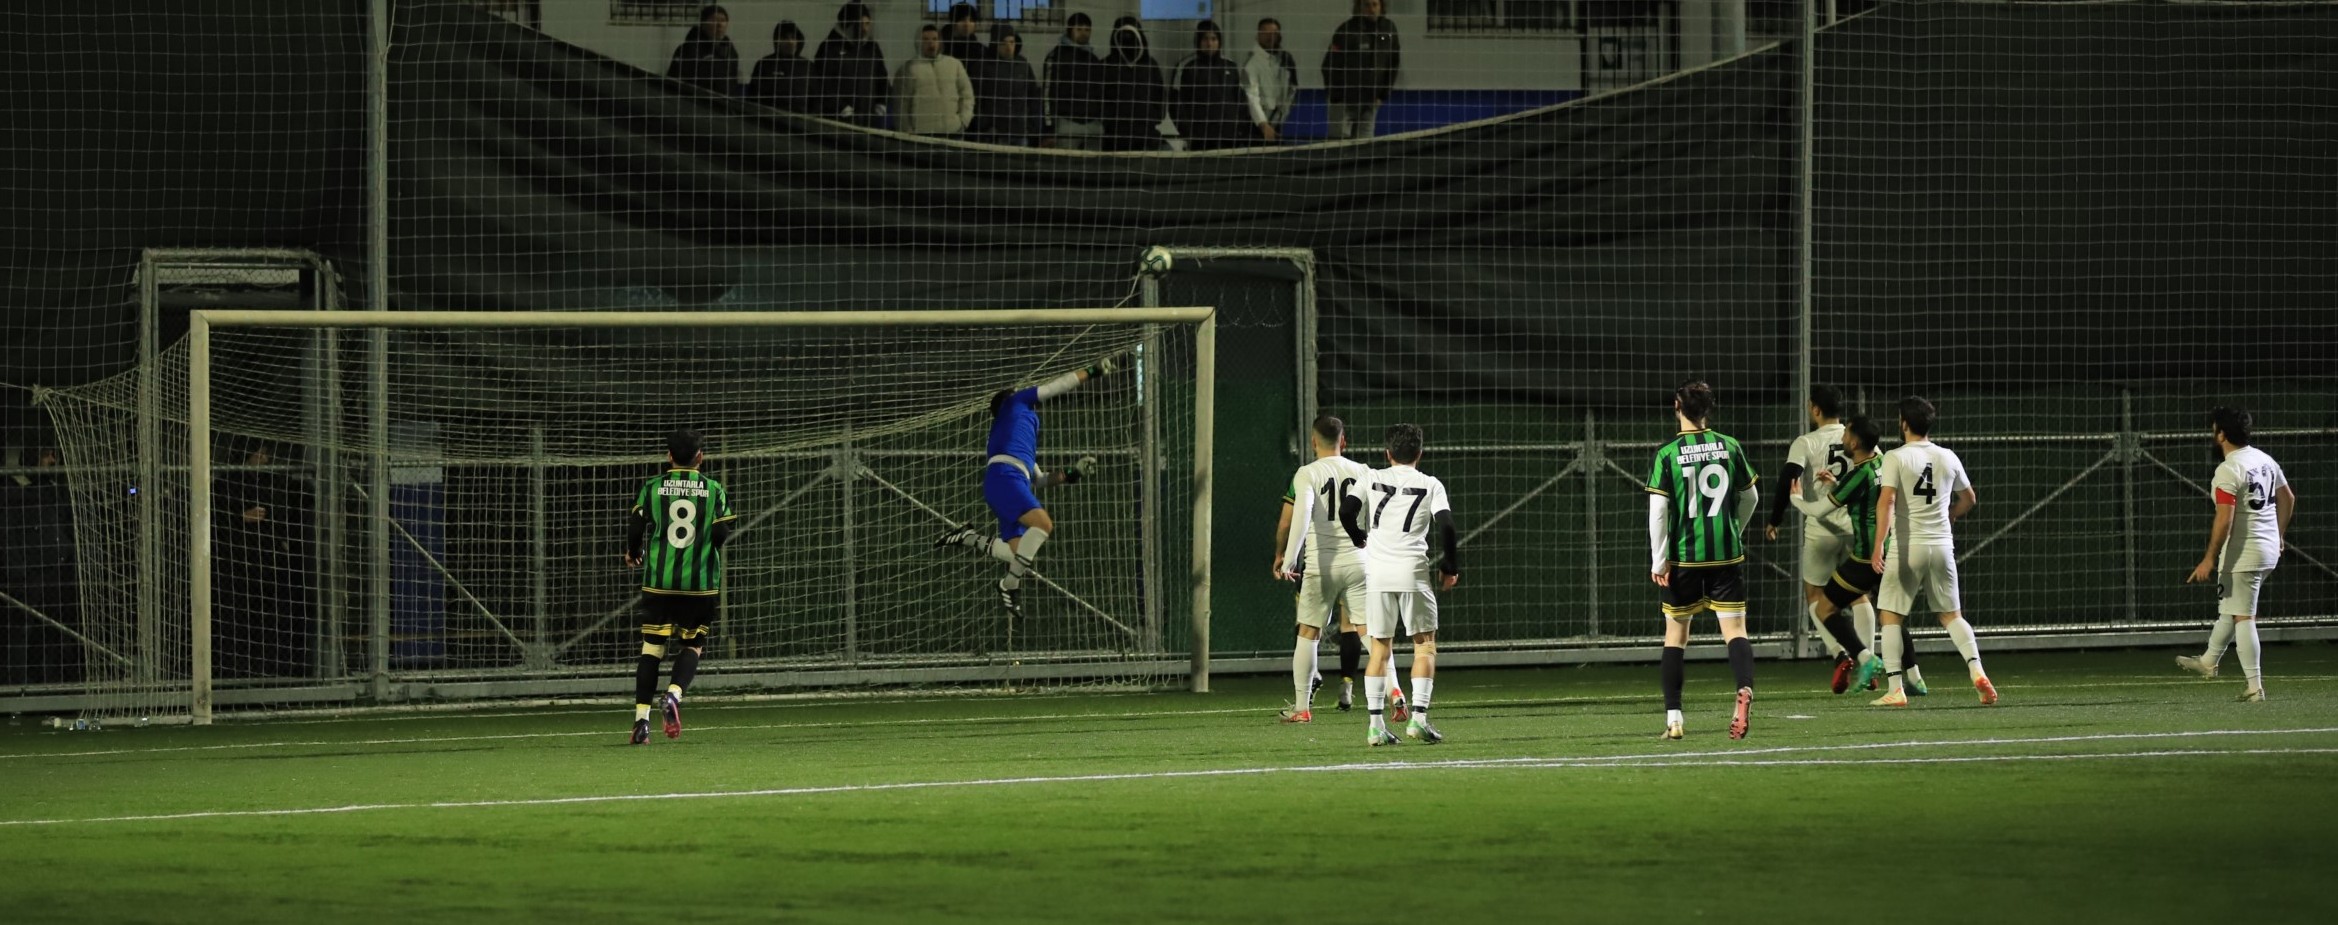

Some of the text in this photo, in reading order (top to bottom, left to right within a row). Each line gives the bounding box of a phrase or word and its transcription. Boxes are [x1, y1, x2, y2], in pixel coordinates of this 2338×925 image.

[1826, 444, 1848, 482] 5
[1913, 462, 1937, 504] 4
[1371, 482, 1428, 533] 77
[1682, 464, 1729, 519] 19
[667, 499, 697, 549] 8
